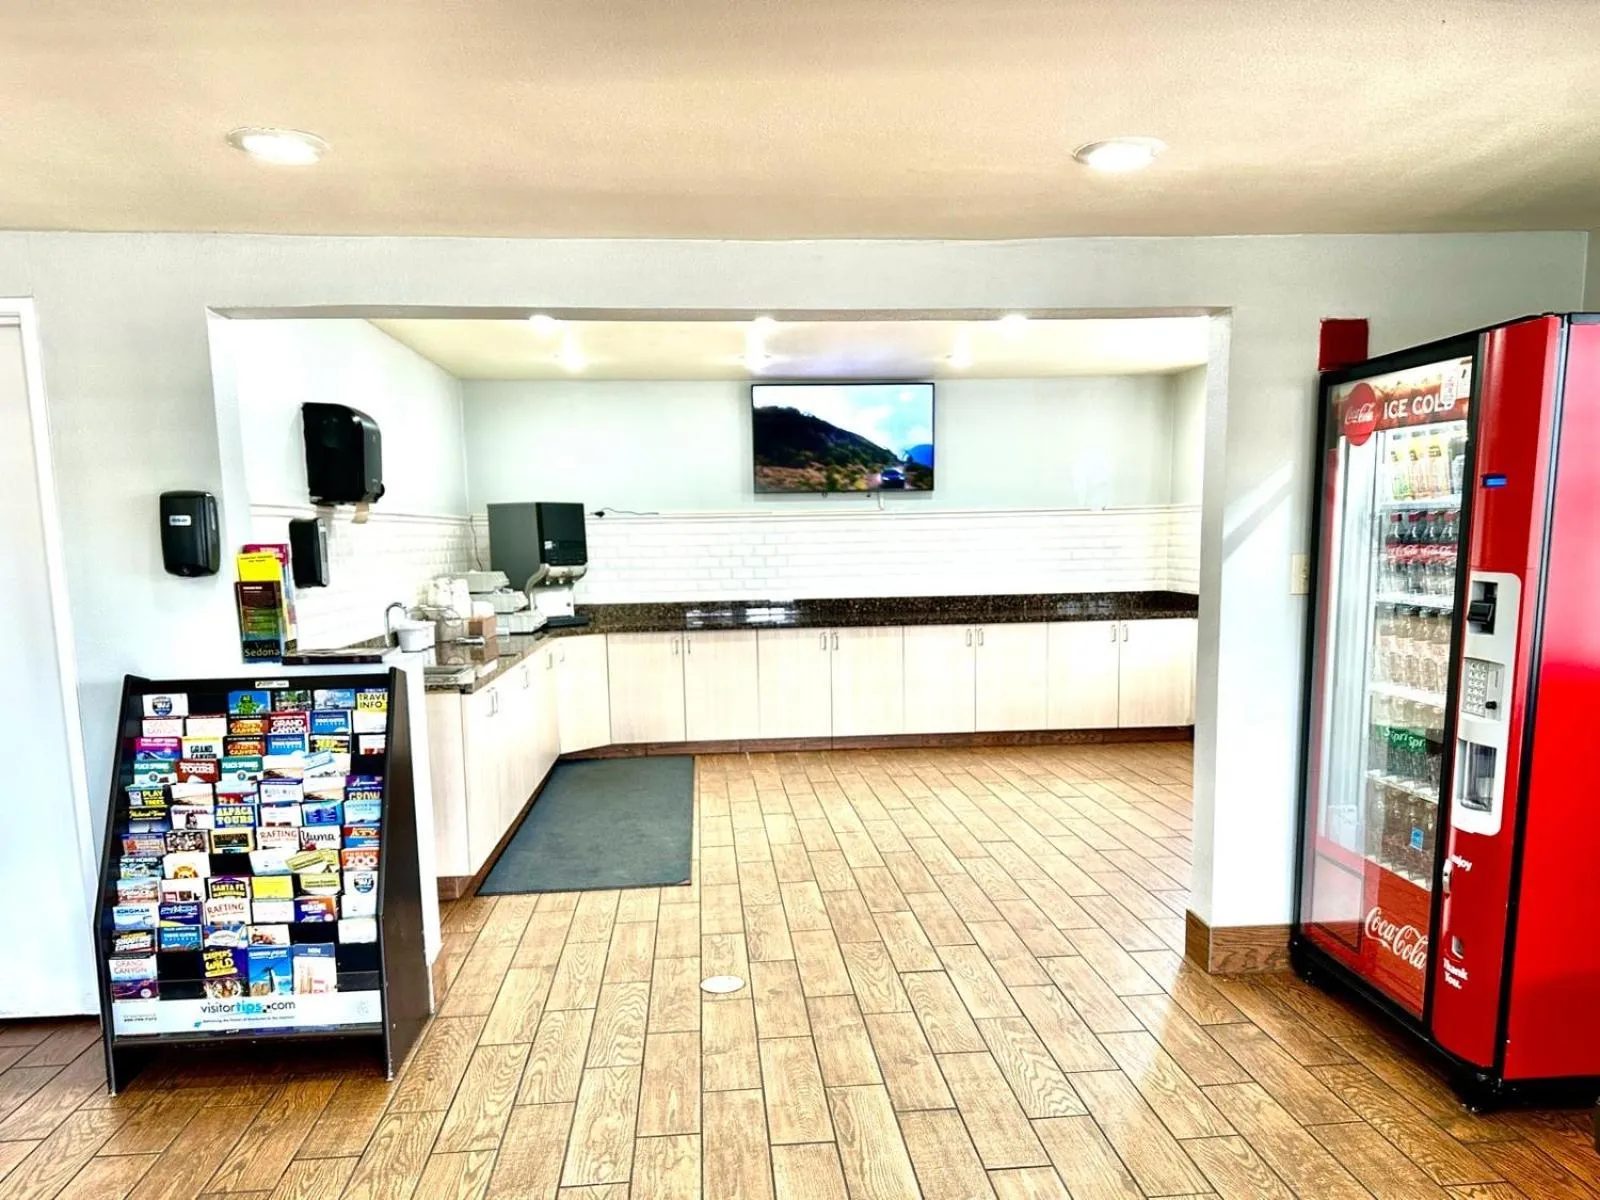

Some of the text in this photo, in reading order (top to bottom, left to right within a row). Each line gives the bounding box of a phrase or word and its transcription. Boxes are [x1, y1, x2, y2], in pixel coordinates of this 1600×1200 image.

[1383, 398, 1408, 420] ICE
[244, 647, 280, 657] Sedona
[359, 693, 386, 701] TRAVE
[360, 701, 383, 709] INFO
[273, 719, 304, 727] GRAND
[190, 745, 213, 753] GRAND
[181, 764, 215, 773] TOURS
[143, 790, 163, 798] PLAY
[216, 806, 253, 816] ALPACA
[216, 816, 254, 825] TOURS
[259, 831, 298, 840] RAFTING
[301, 831, 336, 843] Yuma
[347, 856, 378, 867] ZOO
[212, 883, 234, 892] SANTA
[207, 903, 245, 914] RAFTING
[1365, 906, 1429, 970] Coca-Cola
[115, 960, 144, 968] GRAND
[114, 967, 148, 975] CANYON
